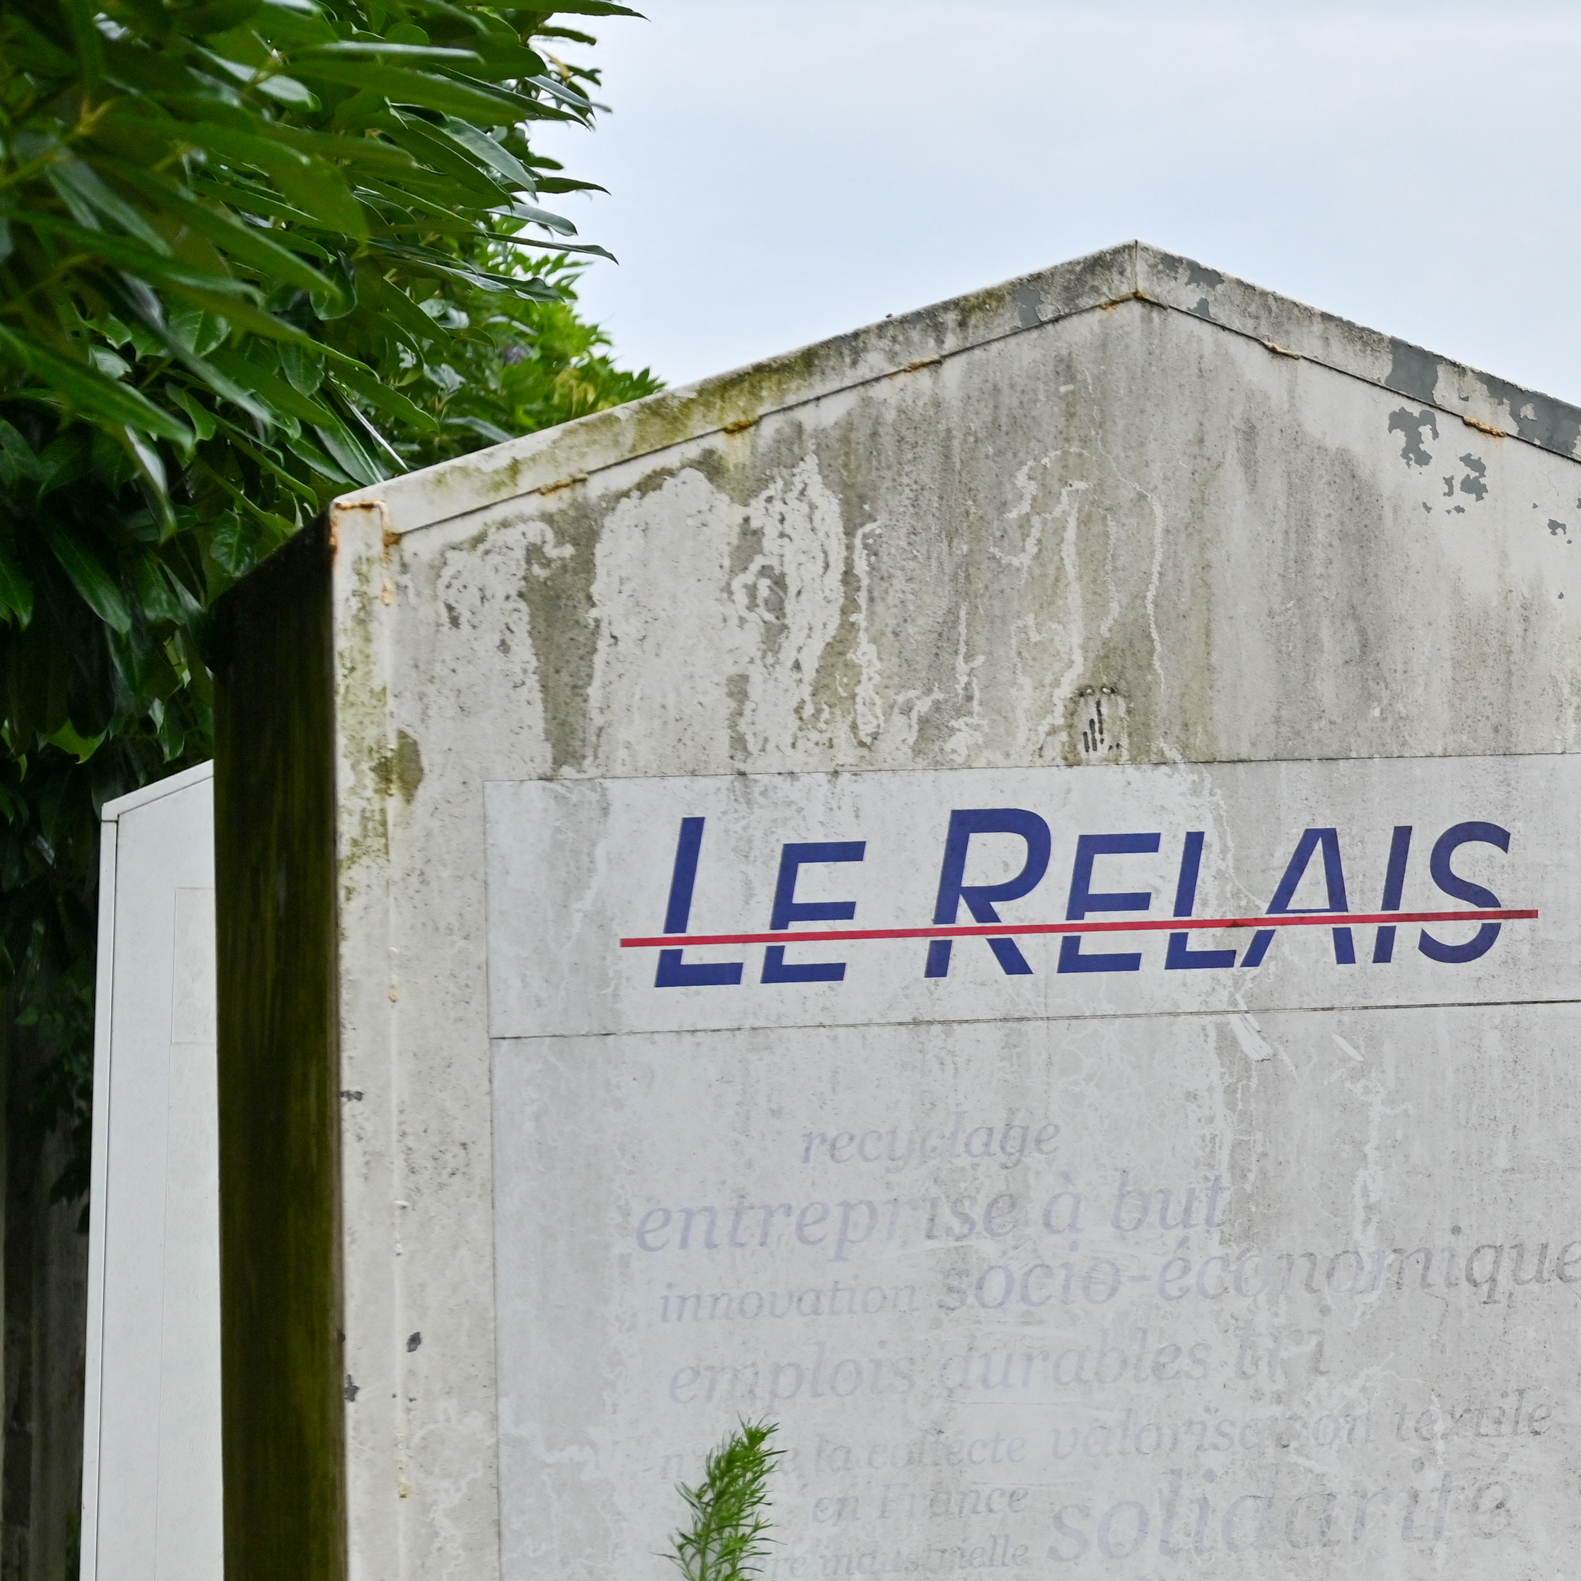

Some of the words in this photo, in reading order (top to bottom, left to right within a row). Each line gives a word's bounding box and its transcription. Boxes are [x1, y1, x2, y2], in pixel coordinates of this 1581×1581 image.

[653, 815, 867, 988] LE
[923, 807, 1513, 980] RELAIS
[802, 1110, 1062, 1174] recyclage
[635, 1188, 1019, 1263] entreprise
[1042, 1170, 1084, 1235] à
[1110, 1167, 1229, 1233] but
[659, 1273, 919, 1324] innovation
[668, 1337, 917, 1413] emplois
[938, 1325, 1212, 1393] durables
